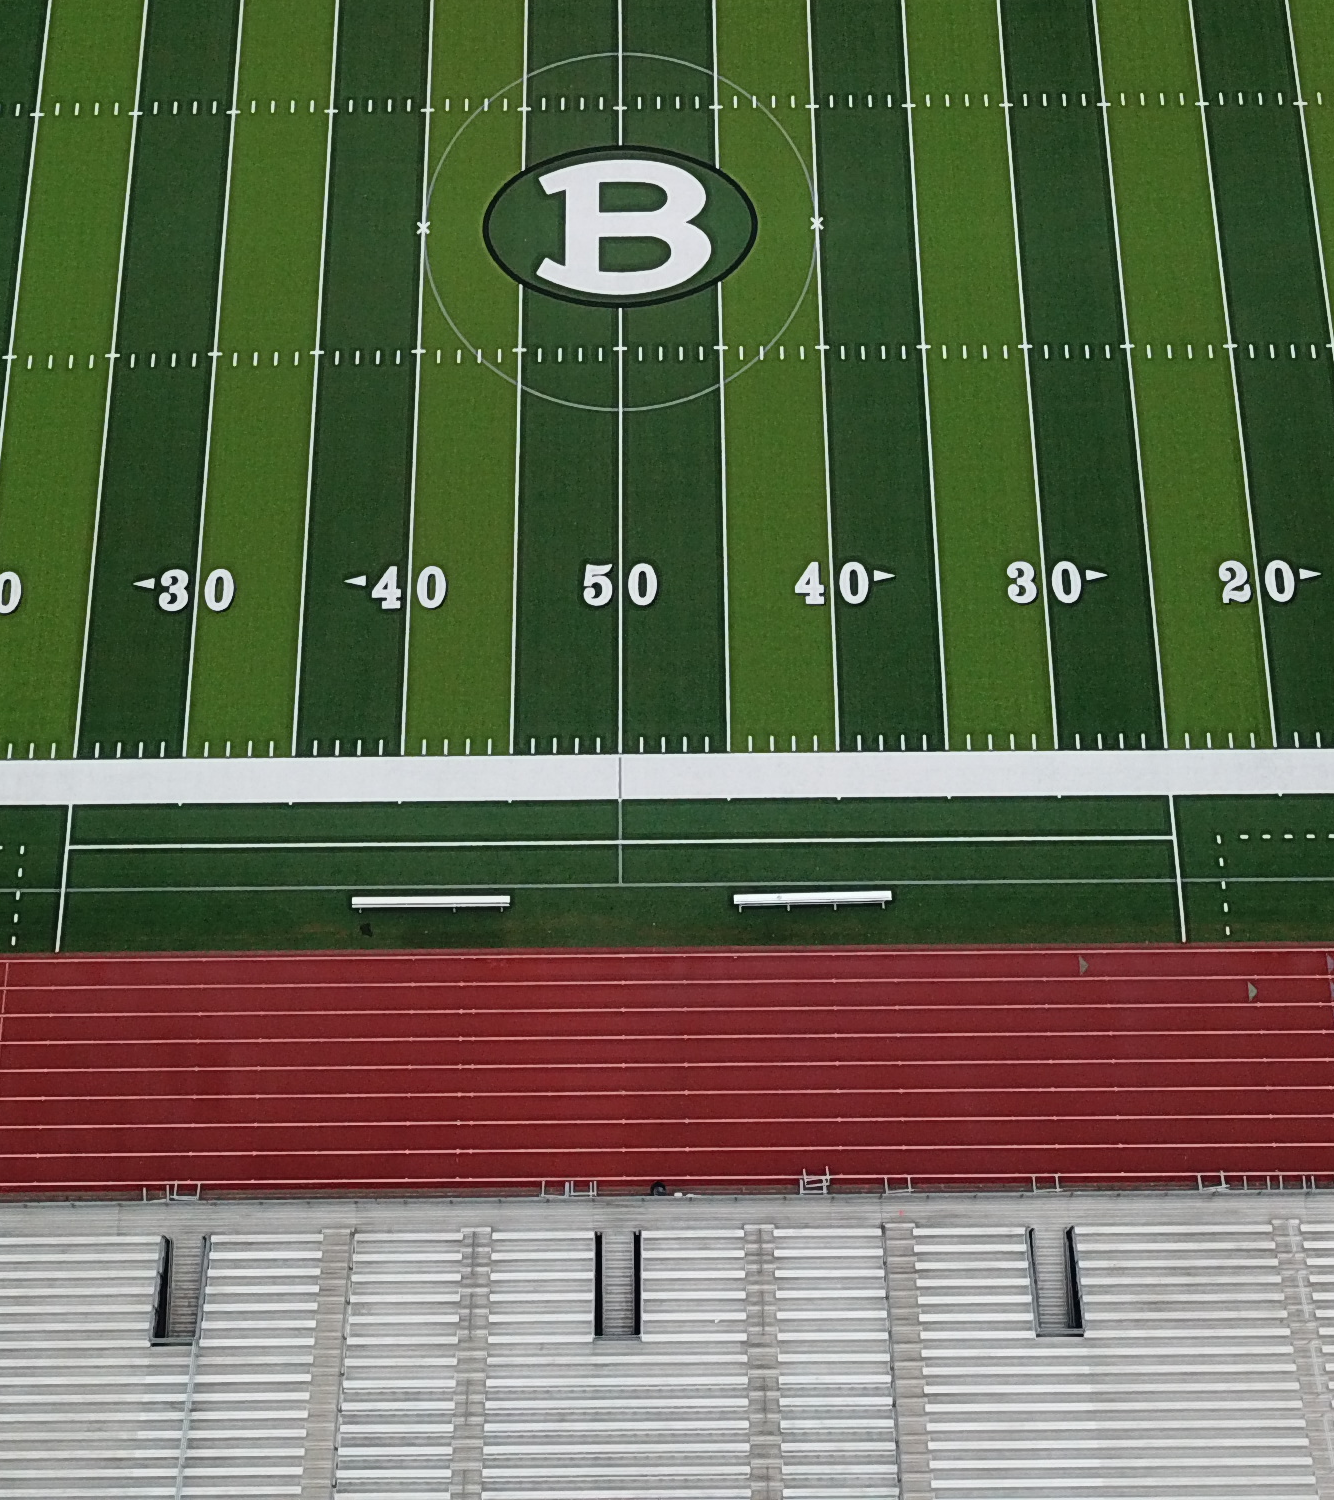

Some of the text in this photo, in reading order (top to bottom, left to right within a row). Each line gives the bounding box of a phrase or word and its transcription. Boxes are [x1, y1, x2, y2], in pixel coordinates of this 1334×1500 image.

[536, 159, 712, 295] B
[157, 570, 235, 612] 30
[370, 566, 447, 610] 40
[583, 564, 658, 607] 50
[794, 561, 869, 604] 40
[1007, 562, 1082, 604] 30
[1219, 560, 1296, 603] 20
